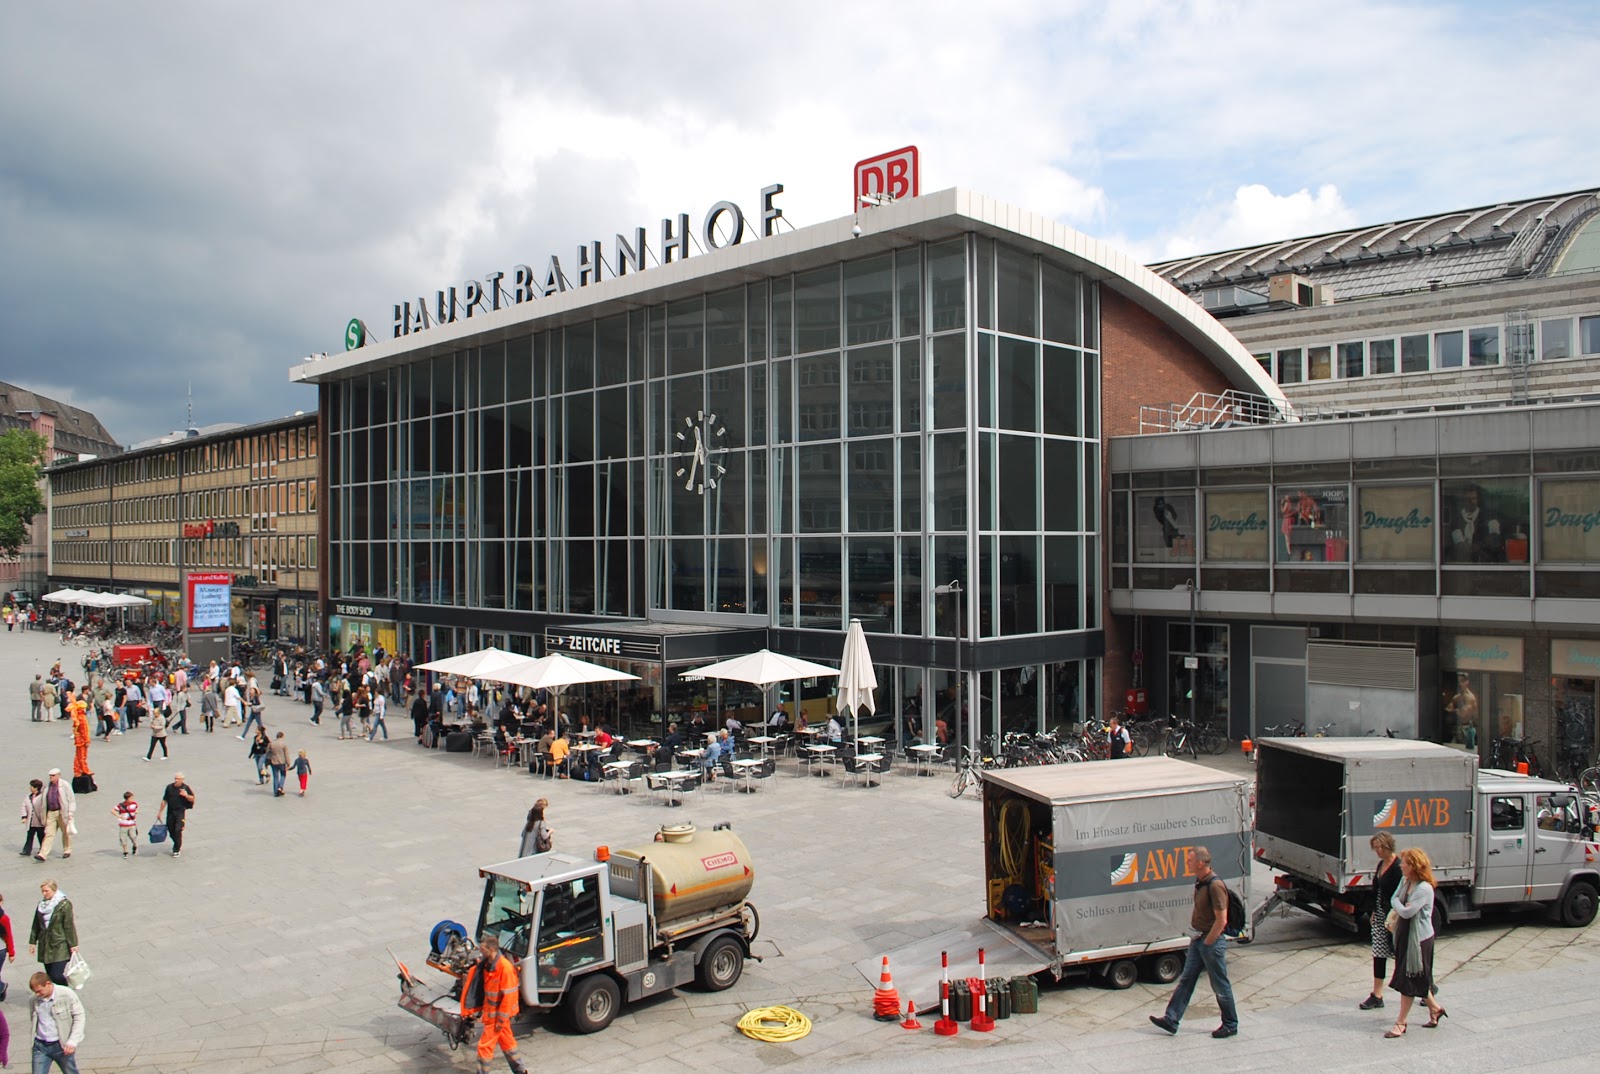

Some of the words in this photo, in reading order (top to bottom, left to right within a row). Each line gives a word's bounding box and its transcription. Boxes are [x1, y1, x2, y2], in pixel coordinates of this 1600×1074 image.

[861, 158, 909, 208] DB
[391, 183, 784, 339] HAUPTBAHNHOF
[347, 322, 358, 350] S
[1208, 511, 1268, 536] Douglas
[1361, 507, 1432, 535] Douglas
[336, 604, 346, 614] THE
[346, 605, 359, 615] BODY
[359, 606, 373, 616] SHOP
[569, 635, 621, 654] ZEITCAFE
[1399, 797, 1450, 827] AWB
[1075, 829, 1090, 840] Im
[1093, 826, 1129, 839] Einsatz
[1132, 822, 1147, 834] für
[1149, 819, 1188, 831] saubere
[1190, 814, 1231, 827] Straßen.
[706, 855, 733, 867] CHEMO
[1076, 906, 1115, 920] Schluss
[1118, 901, 1135, 914] mit
[1138, 897, 1193, 911] Kaugummi
[644, 974, 654, 985] 50
